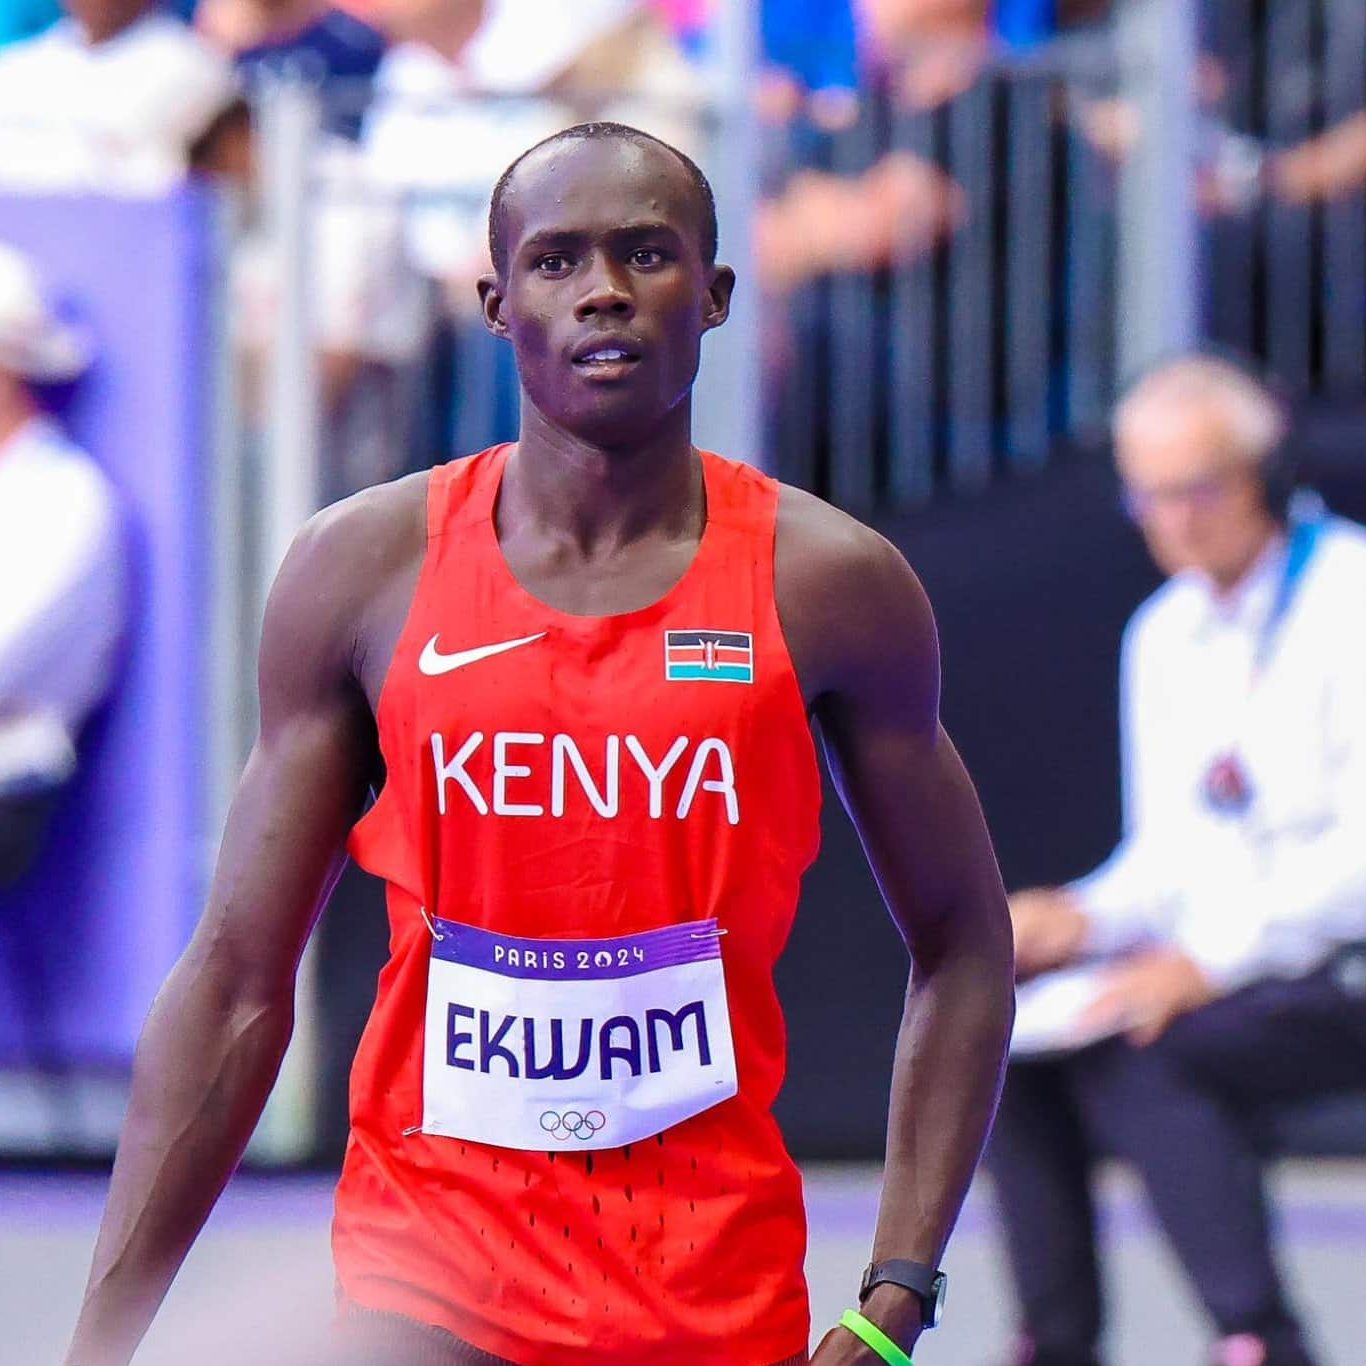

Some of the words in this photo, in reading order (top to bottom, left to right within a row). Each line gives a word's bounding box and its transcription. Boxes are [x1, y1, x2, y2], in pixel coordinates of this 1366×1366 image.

[430, 731, 740, 825] KENYA
[494, 945, 566, 969] PARIS
[577, 946, 644, 969] 2024
[446, 1000, 712, 1081] EKWAM
